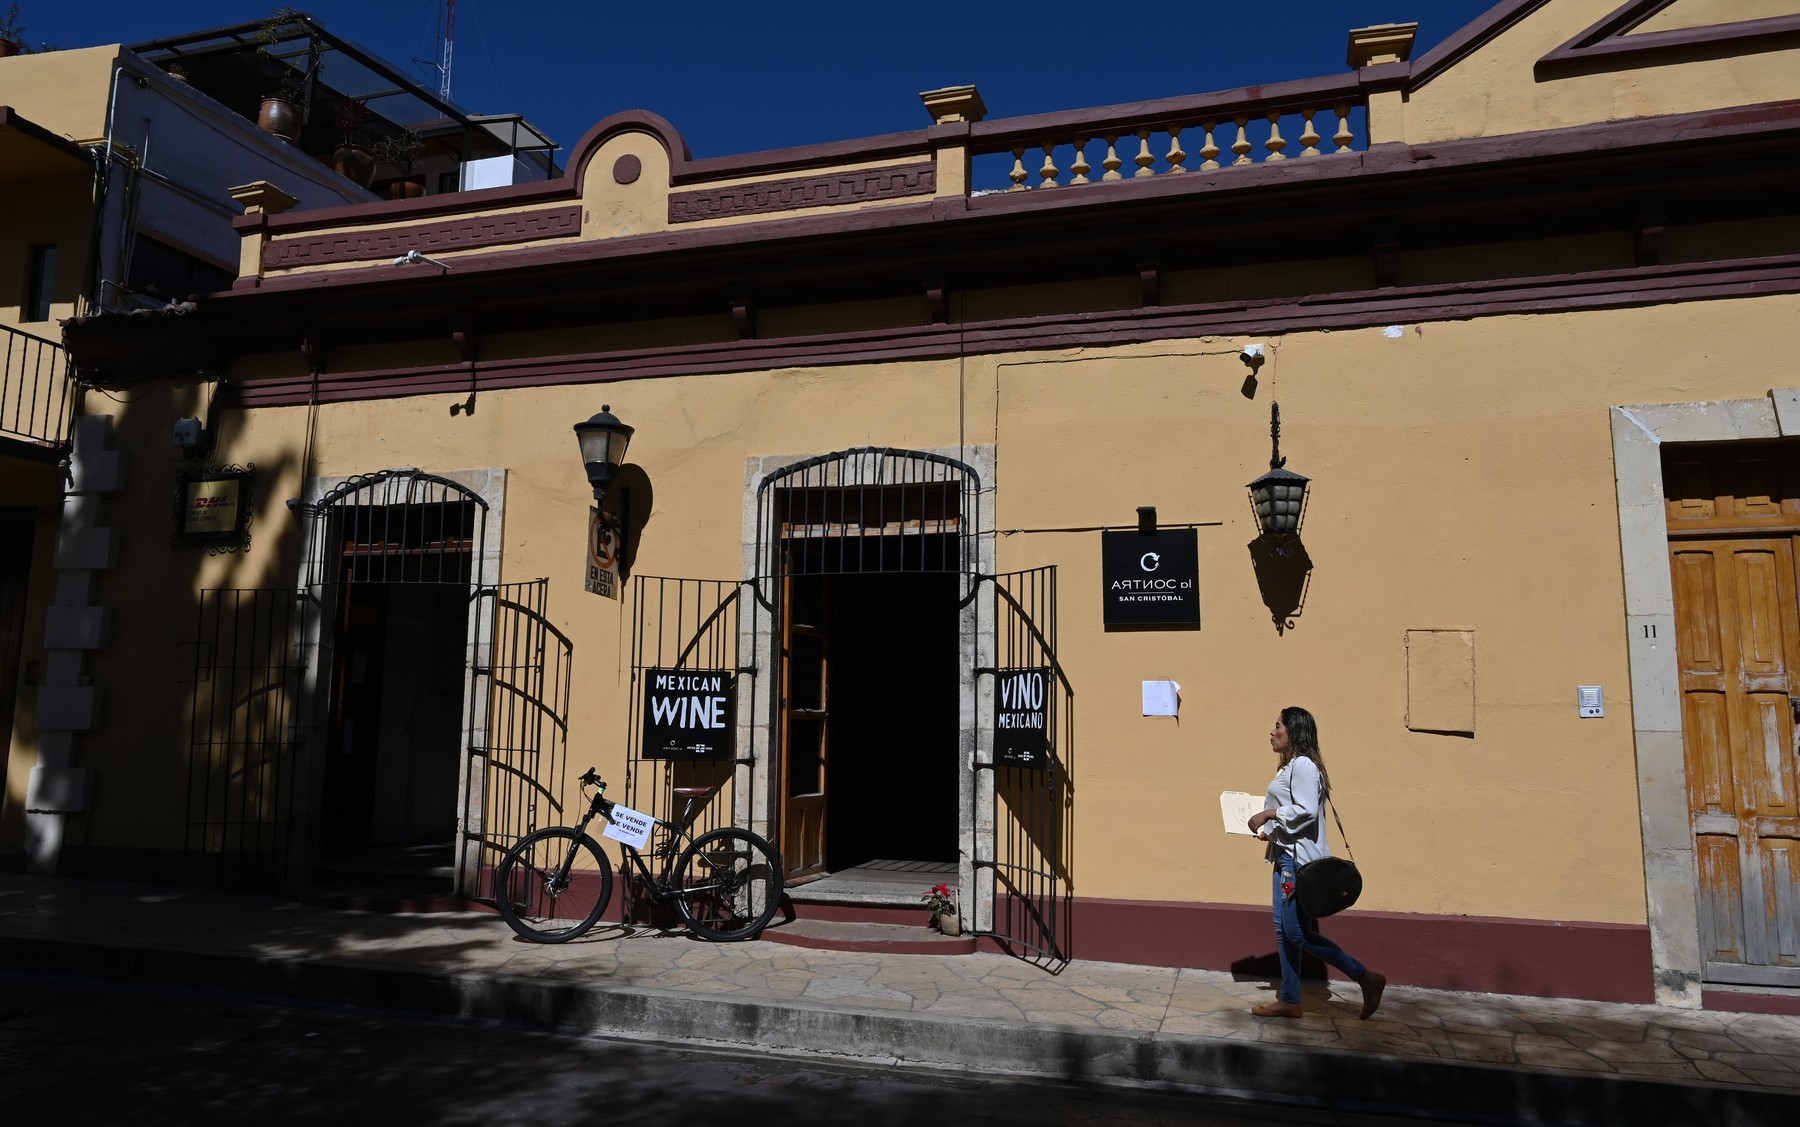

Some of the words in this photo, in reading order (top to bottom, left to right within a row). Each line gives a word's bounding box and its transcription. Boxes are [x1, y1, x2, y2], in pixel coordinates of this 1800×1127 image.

[194, 496, 229, 508] DHL
[590, 565, 599, 580] EN
[600, 569, 614, 585] ESTA
[592, 580, 611, 598] ACERA
[1643, 625, 1657, 638] 11
[656, 675, 721, 692] MEXICAN
[1001, 672, 1043, 710] VINO
[651, 695, 726, 729] WINE
[998, 712, 1043, 729] MEXICANO
[615, 811, 625, 819] SE
[625, 815, 648, 828] VENDE
[622, 823, 645, 836] VENDE
